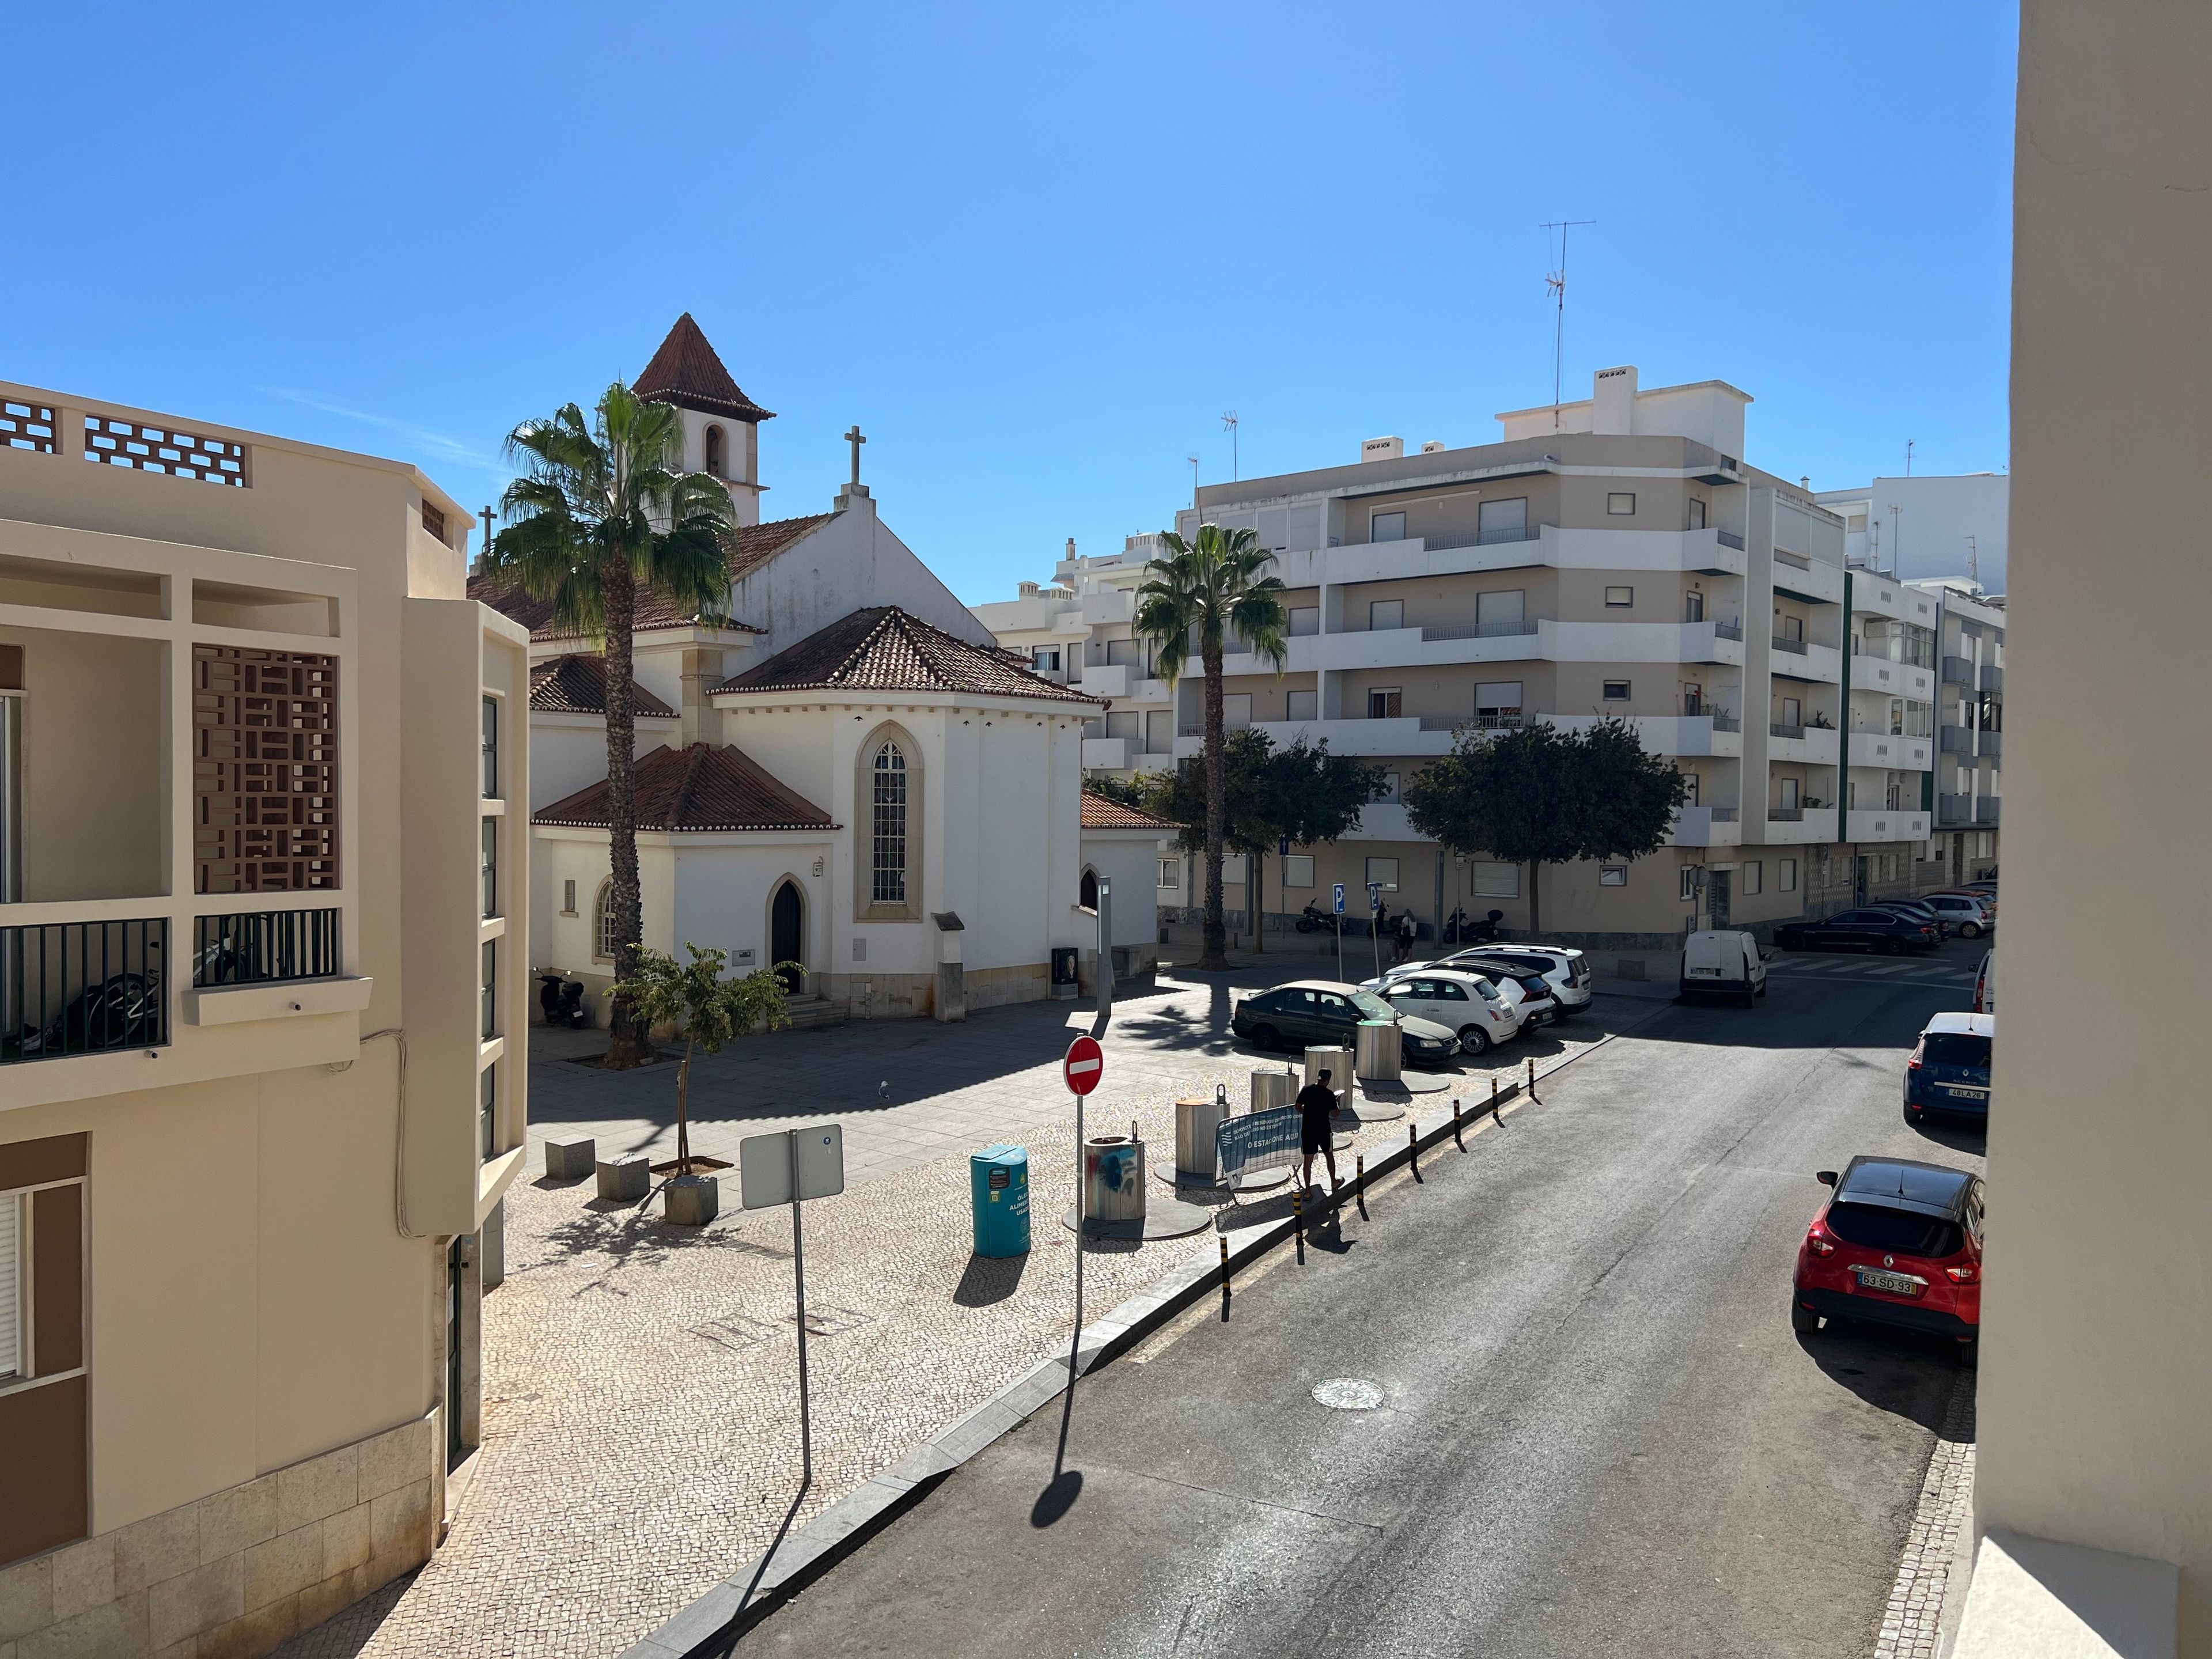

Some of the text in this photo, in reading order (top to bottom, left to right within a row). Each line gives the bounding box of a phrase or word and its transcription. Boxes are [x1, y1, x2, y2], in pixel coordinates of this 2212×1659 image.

[1336, 887, 1343, 911] P
[1370, 886, 1377, 908] P
[1285, 1132, 1298, 1141] AQUI
